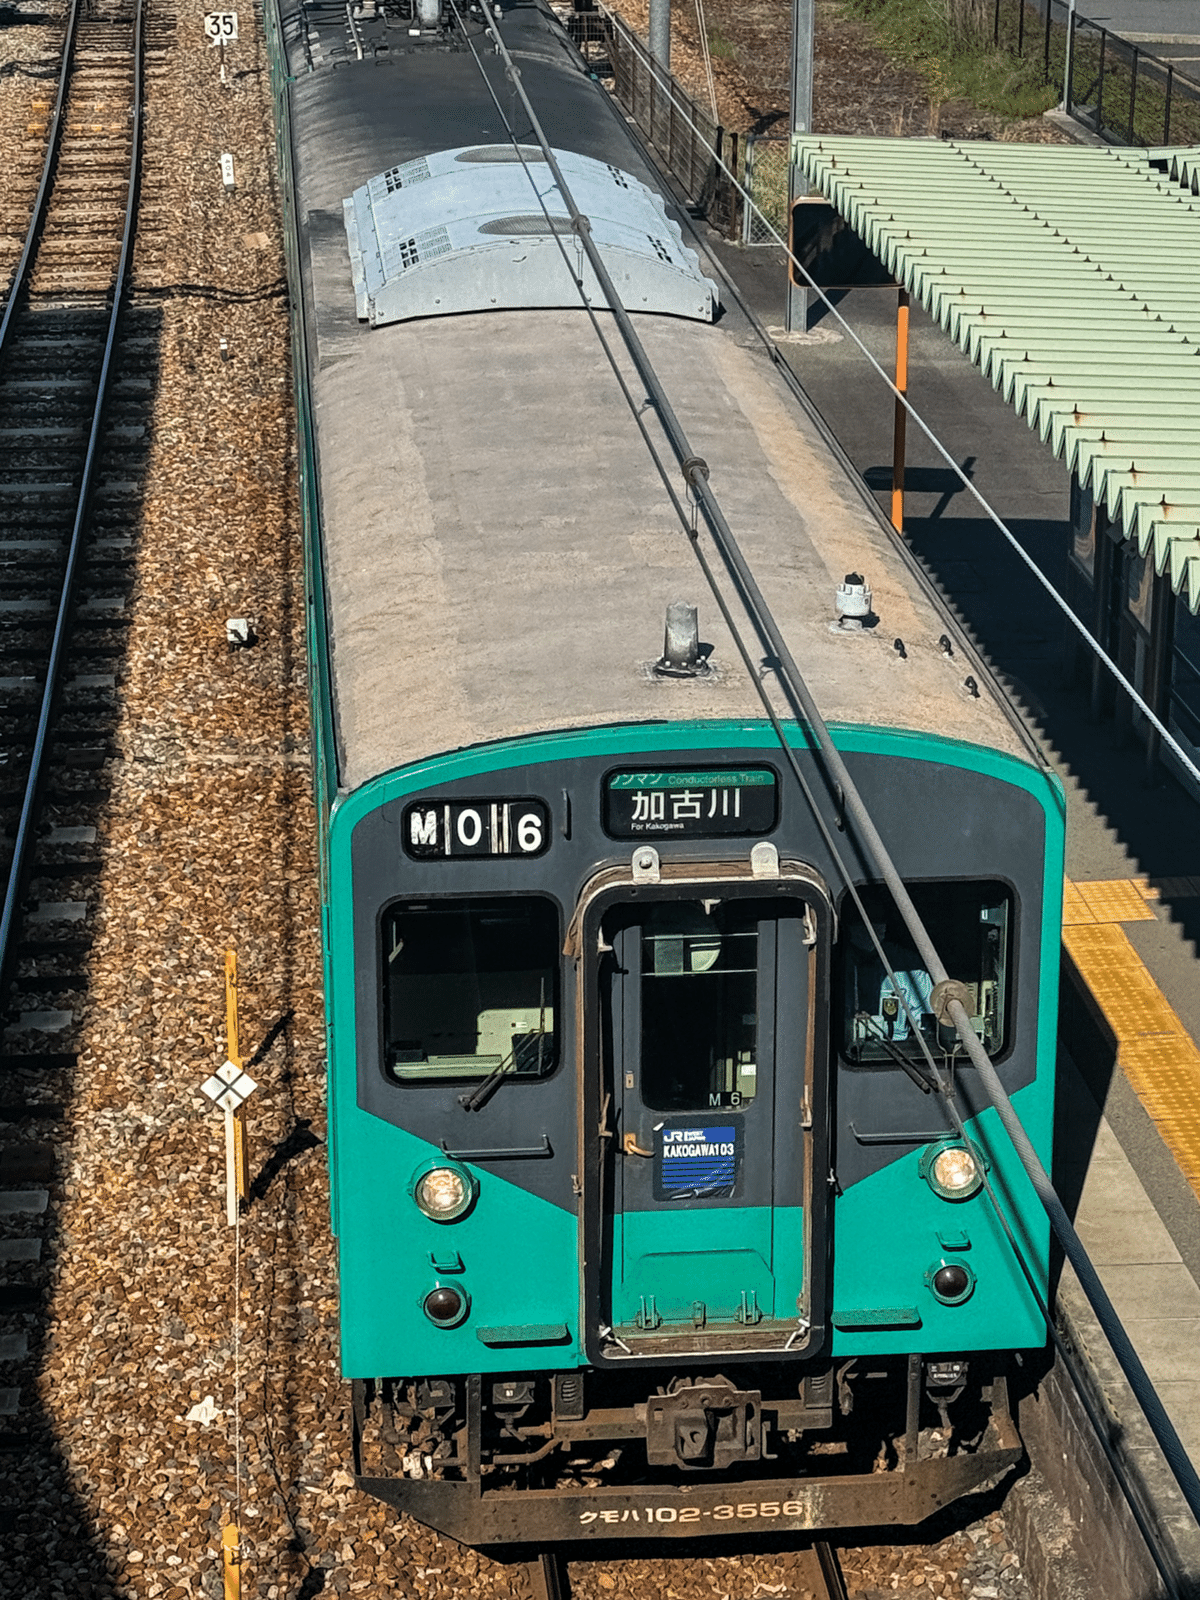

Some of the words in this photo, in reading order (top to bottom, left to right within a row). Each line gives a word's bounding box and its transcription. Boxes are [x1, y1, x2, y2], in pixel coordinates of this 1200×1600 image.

[210, 15, 233, 36] 35
[668, 774, 737, 785] Conductorless
[739, 773, 764, 783] Train
[631, 788, 741, 821] 加古川
[410, 810, 437, 845] M
[517, 813, 542, 852] 6
[631, 823, 645, 831] For
[646, 822, 684, 832] Kakogawa
[709, 1093, 721, 1106] M
[730, 1092, 740, 1106] 6
[663, 1131, 683, 1142] JR
[663, 1143, 735, 1158] KAKOGAWA103
